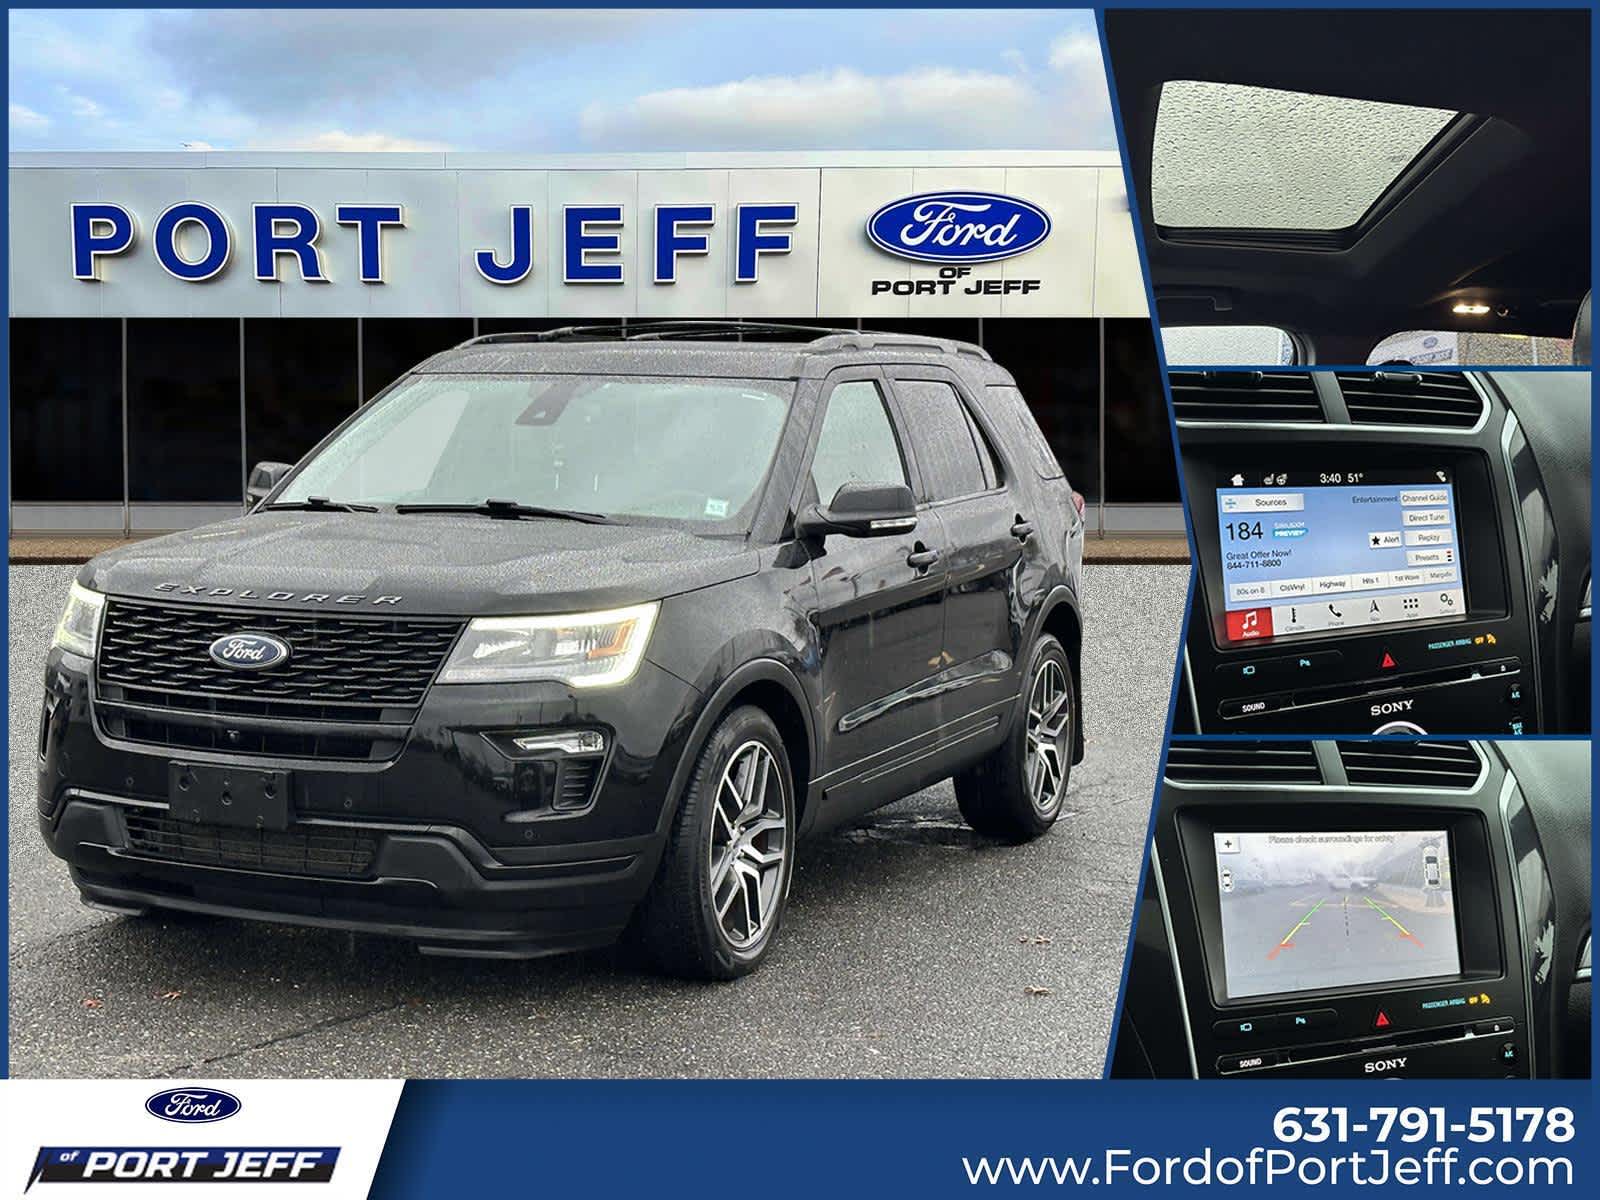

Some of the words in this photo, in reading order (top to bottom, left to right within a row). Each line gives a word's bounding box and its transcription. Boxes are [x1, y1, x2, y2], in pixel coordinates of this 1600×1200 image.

[899, 201, 1021, 246] Ford
[70, 200, 405, 283] PORT
[475, 202, 799, 284] JEFF
[938, 267, 972, 279] OF
[871, 280, 957, 296] PORT
[964, 279, 1041, 295] JEFF
[1319, 473, 1342, 484] 3:40
[1255, 497, 1287, 507] Sources
[1408, 513, 1428, 522] Direct
[1429, 512, 1445, 521] Tune
[1224, 520, 1264, 541] 184
[1383, 536, 1400, 544] Alert
[1226, 551, 1249, 561] Great
[1415, 552, 1440, 561] Presets
[1319, 580, 1346, 588] Highway
[1362, 576, 1374, 585] Hits
[154, 582, 402, 605] EXPLORER
[1241, 630, 1260, 638] Audio
[221, 639, 264, 661] Ford
[1242, 701, 1266, 713] SOUND
[1370, 699, 1414, 716] SONY
[1239, 1057, 1262, 1068] SOUND
[1364, 1057, 1408, 1073] SONY
